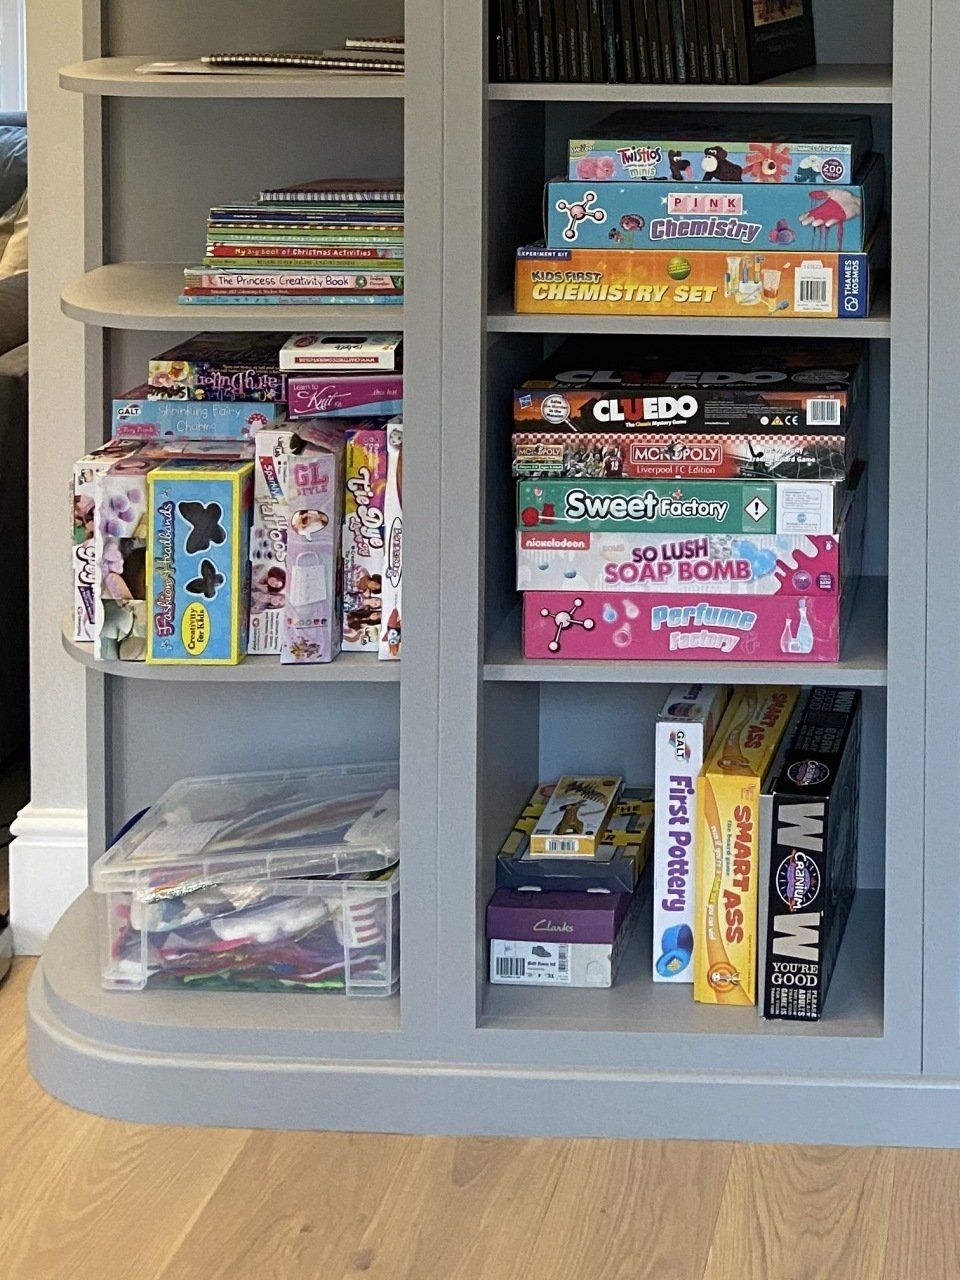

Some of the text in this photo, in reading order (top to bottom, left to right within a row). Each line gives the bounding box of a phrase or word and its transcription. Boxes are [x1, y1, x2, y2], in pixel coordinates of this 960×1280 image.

[617, 145, 663, 166] Twistios
[628, 166, 658, 179] minis
[822, 164, 845, 175] 200
[650, 218, 762, 244] Chemistry
[218, 275, 349, 288] The Princess Creativity Book
[531, 271, 602, 283] KIDS FIRST
[844, 259, 853, 295] THAMES
[852, 259, 860, 295] KOSMOS
[533, 283, 718, 303] CHEMISTRY SET
[293, 384, 312, 392] Learn
[117, 407, 140, 416] GALT
[157, 405, 242, 419] Shrinking Fairy
[592, 395, 699, 423] CLUEDO
[516, 447, 563, 458] MONOPOLY
[633, 446, 719, 463] MONOPOLY
[263, 464, 281, 497] Sparkly
[636, 465, 716, 477] Liverpool FC Edition
[565, 488, 729, 521] Sweet Factory
[524, 537, 586, 549] nickelodeon
[631, 538, 710, 563] SO LUSH
[604, 559, 752, 585] SOAP BOMB
[651, 603, 758, 631] Perfume
[187, 608, 198, 650] Creativity
[675, 730, 685, 759] GALT
[661, 775, 695, 913] First Pottery
[722, 804, 752, 945] SMART ASS
[532, 919, 575, 933] Clarks
[771, 961, 819, 975] YOU'RE
[771, 974, 819, 988] GOOD
